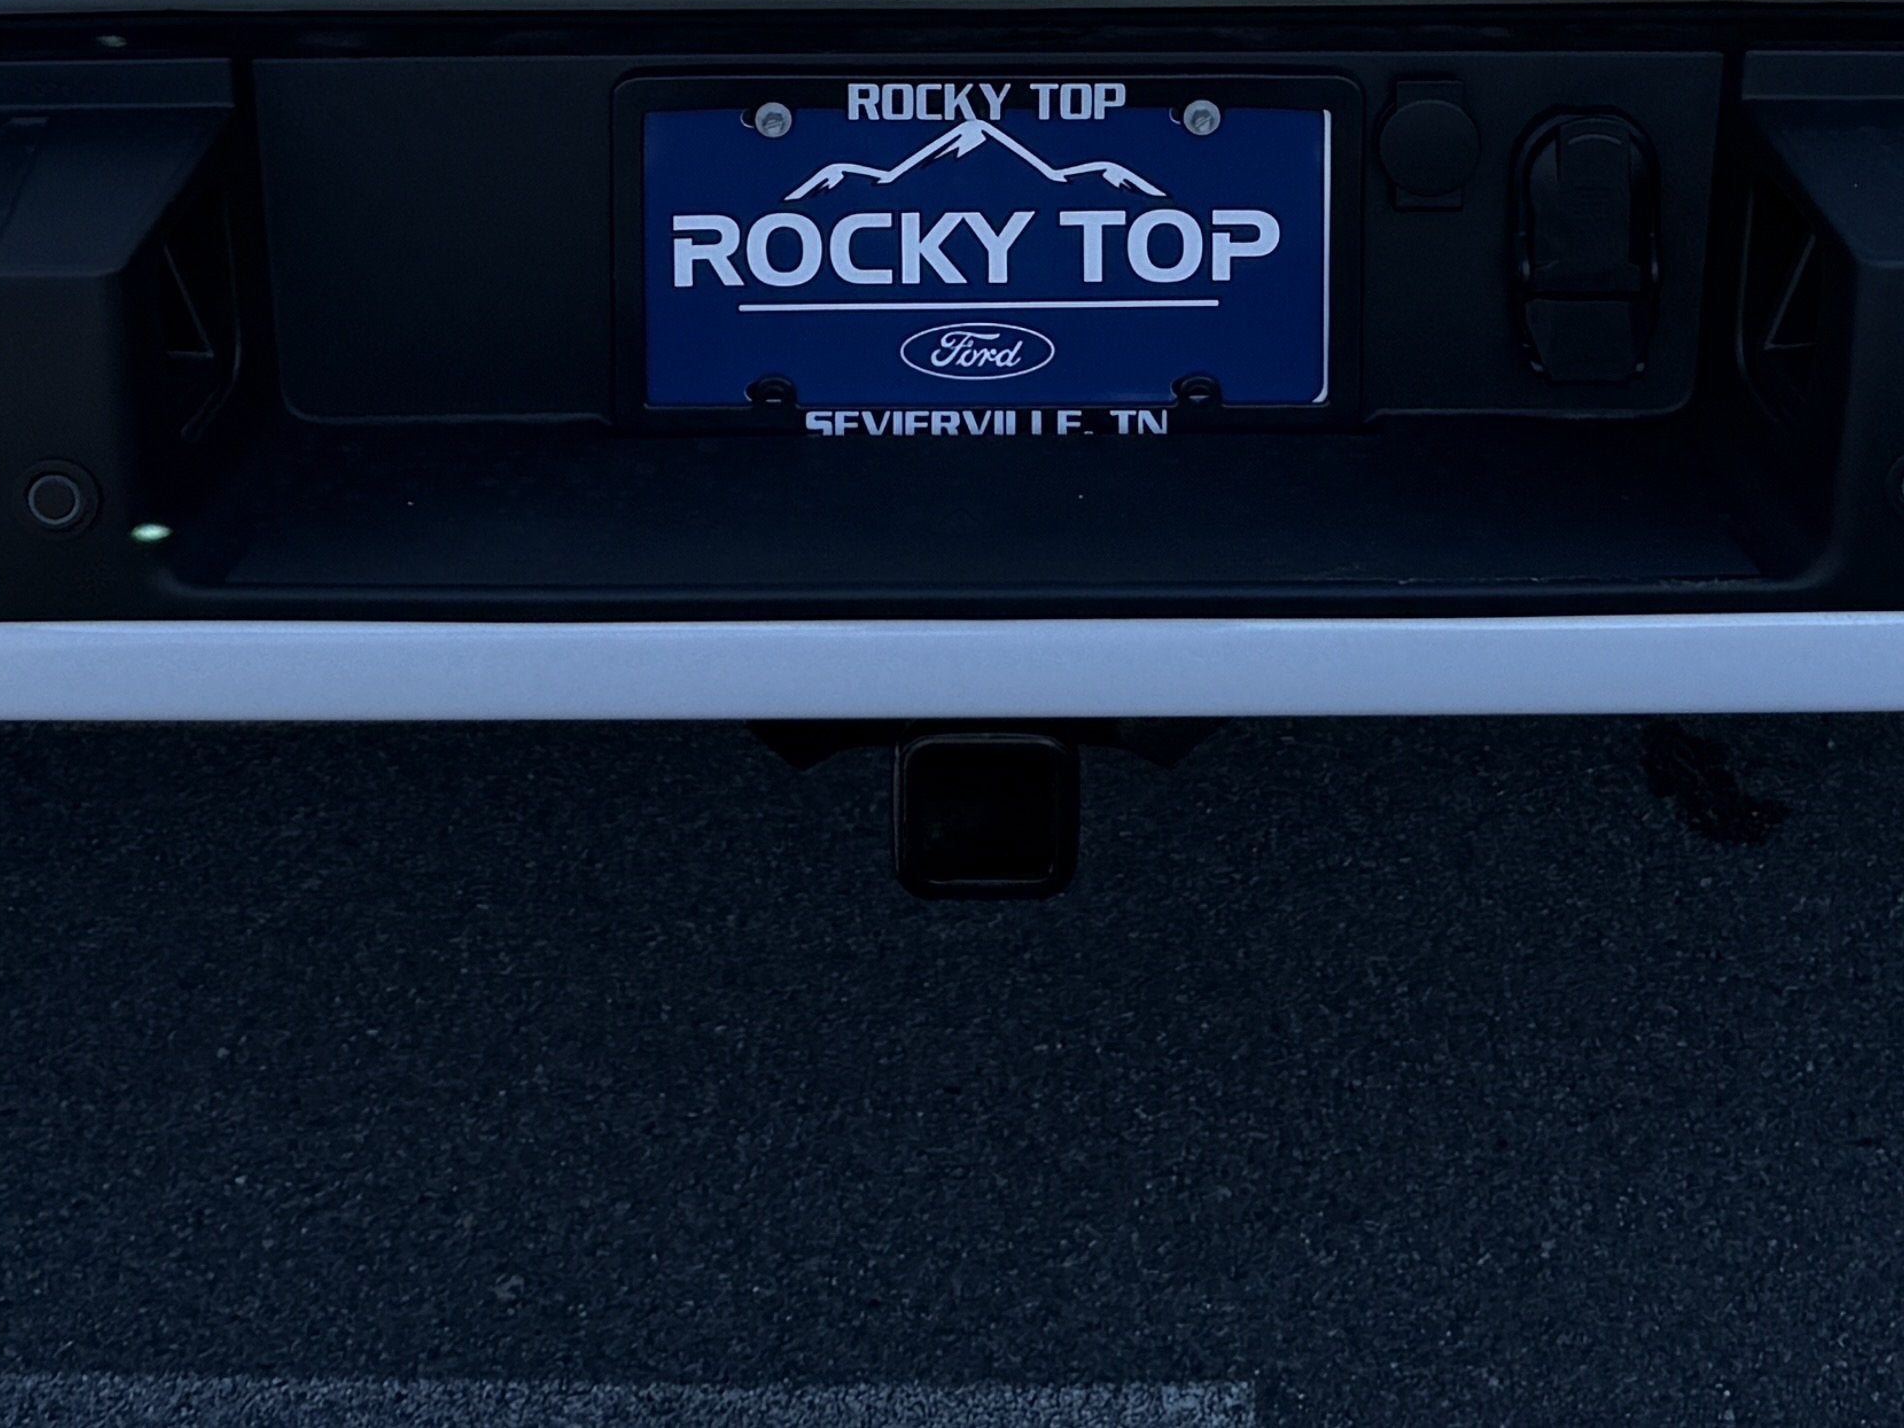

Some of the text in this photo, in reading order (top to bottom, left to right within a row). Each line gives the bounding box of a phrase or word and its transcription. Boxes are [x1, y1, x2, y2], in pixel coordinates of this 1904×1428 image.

[848, 83, 1126, 121] ROCKY TOP
[672, 210, 1280, 287] ROCKY TOP
[931, 331, 1023, 368] Ford
[1109, 409, 1168, 435] TN
